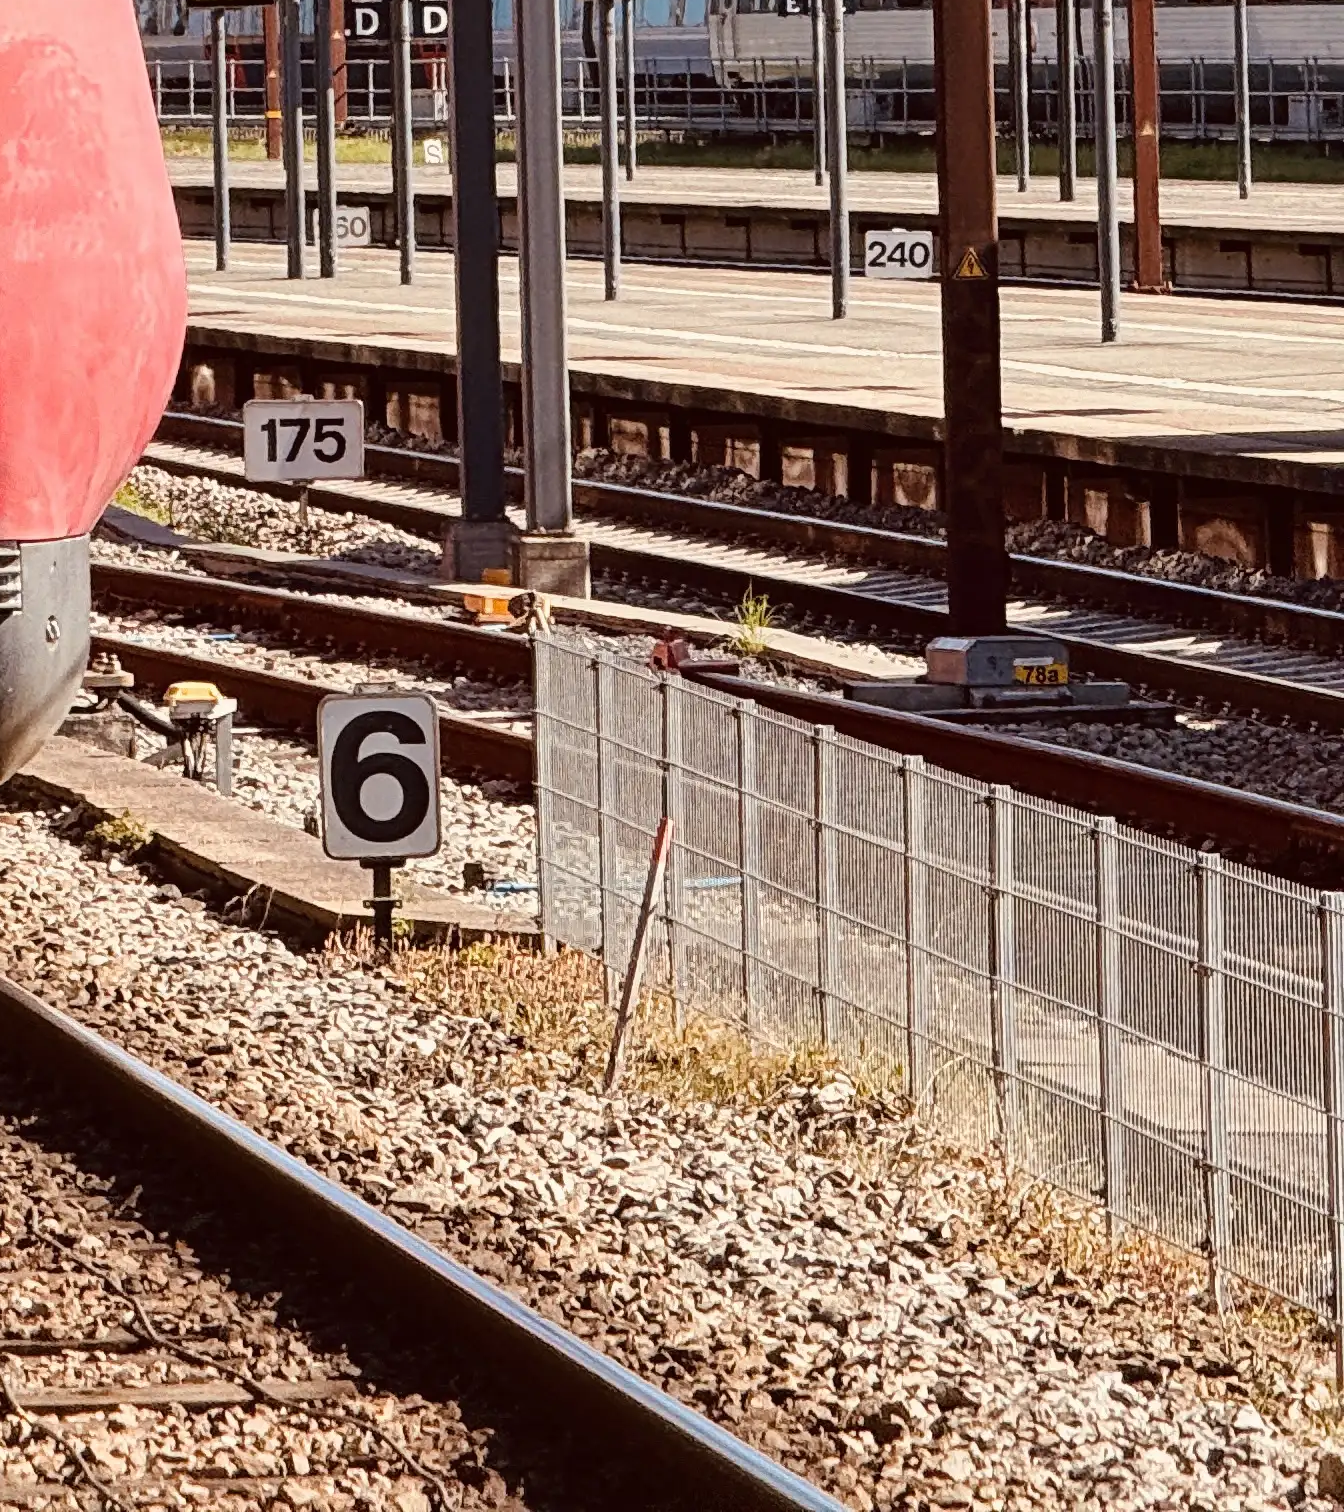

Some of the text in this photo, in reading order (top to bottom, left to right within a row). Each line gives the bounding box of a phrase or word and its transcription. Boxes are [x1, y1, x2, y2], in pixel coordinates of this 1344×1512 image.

[423, 6, 448, 34] D
[868, 241, 930, 268] 240
[260, 417, 347, 463] 175
[1023, 665, 1060, 685] 78a
[330, 710, 430, 843] 6
